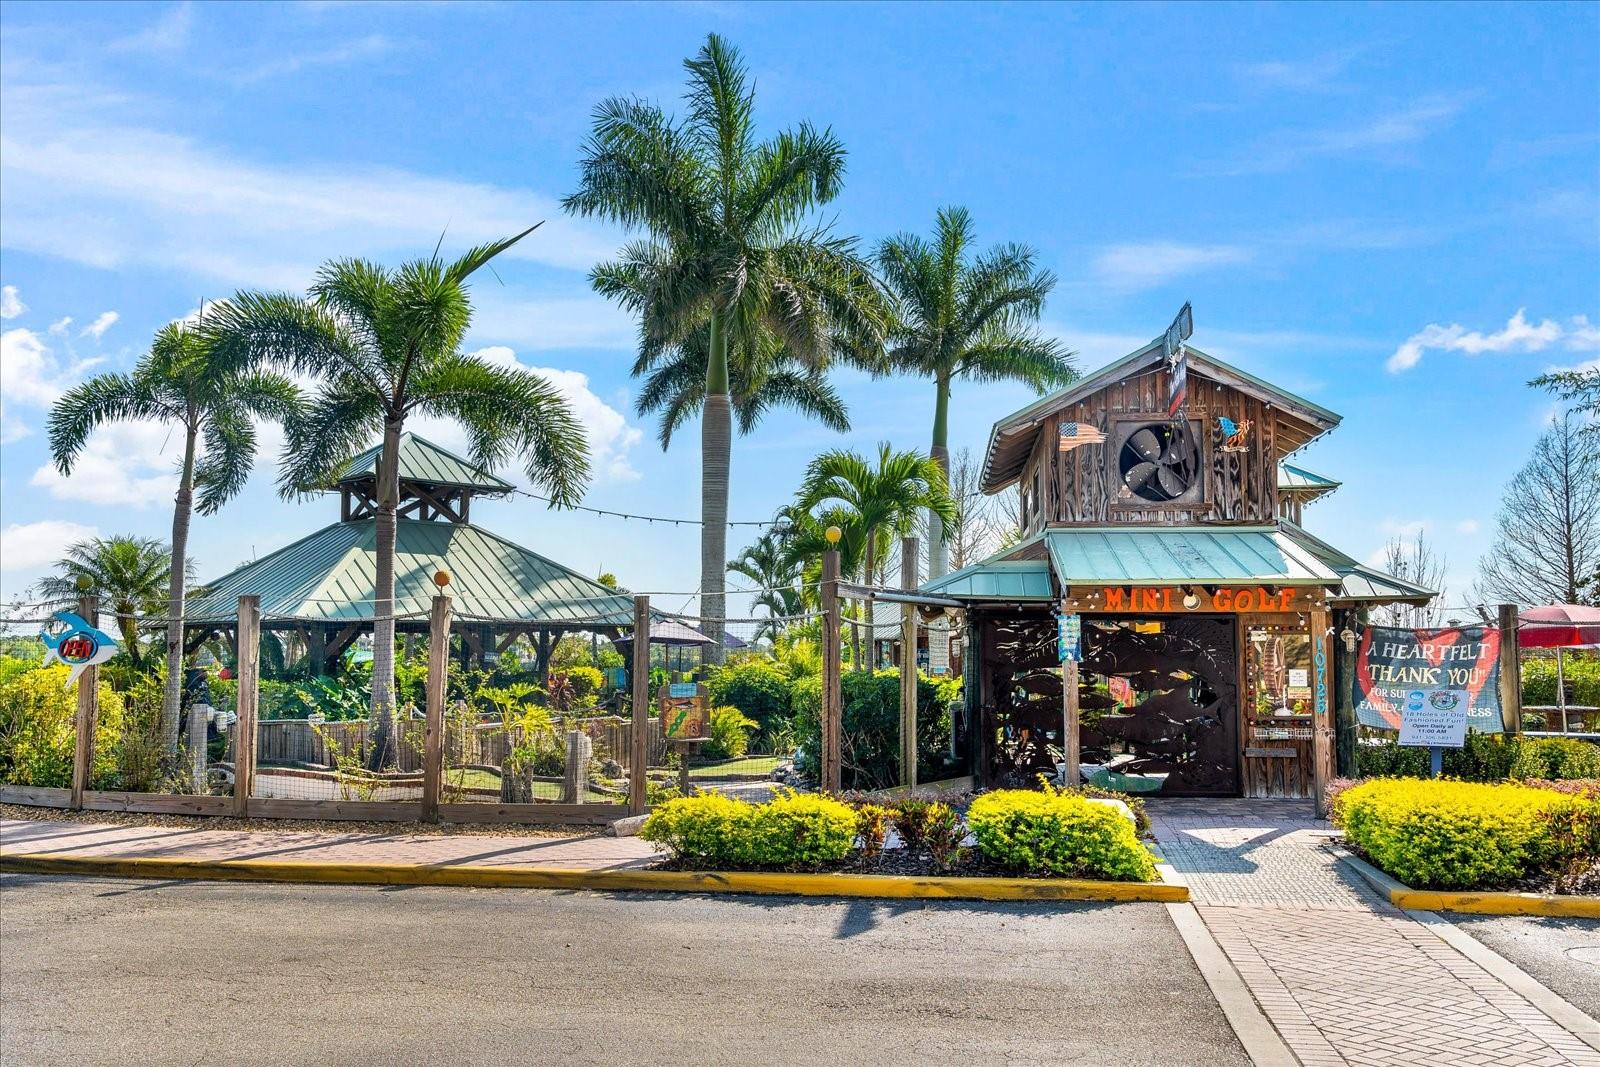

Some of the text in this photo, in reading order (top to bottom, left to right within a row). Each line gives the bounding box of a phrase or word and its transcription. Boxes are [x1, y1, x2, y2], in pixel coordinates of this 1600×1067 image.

[1103, 587, 1297, 612] MINI GOLF
[60, 639, 92, 657] OPEN
[1365, 642, 1491, 661] A HEARTFELT
[1365, 664, 1486, 686] "THANK YOU"
[1370, 687, 1406, 699] FOR SU
[1359, 700, 1405, 713] FAMILY-
